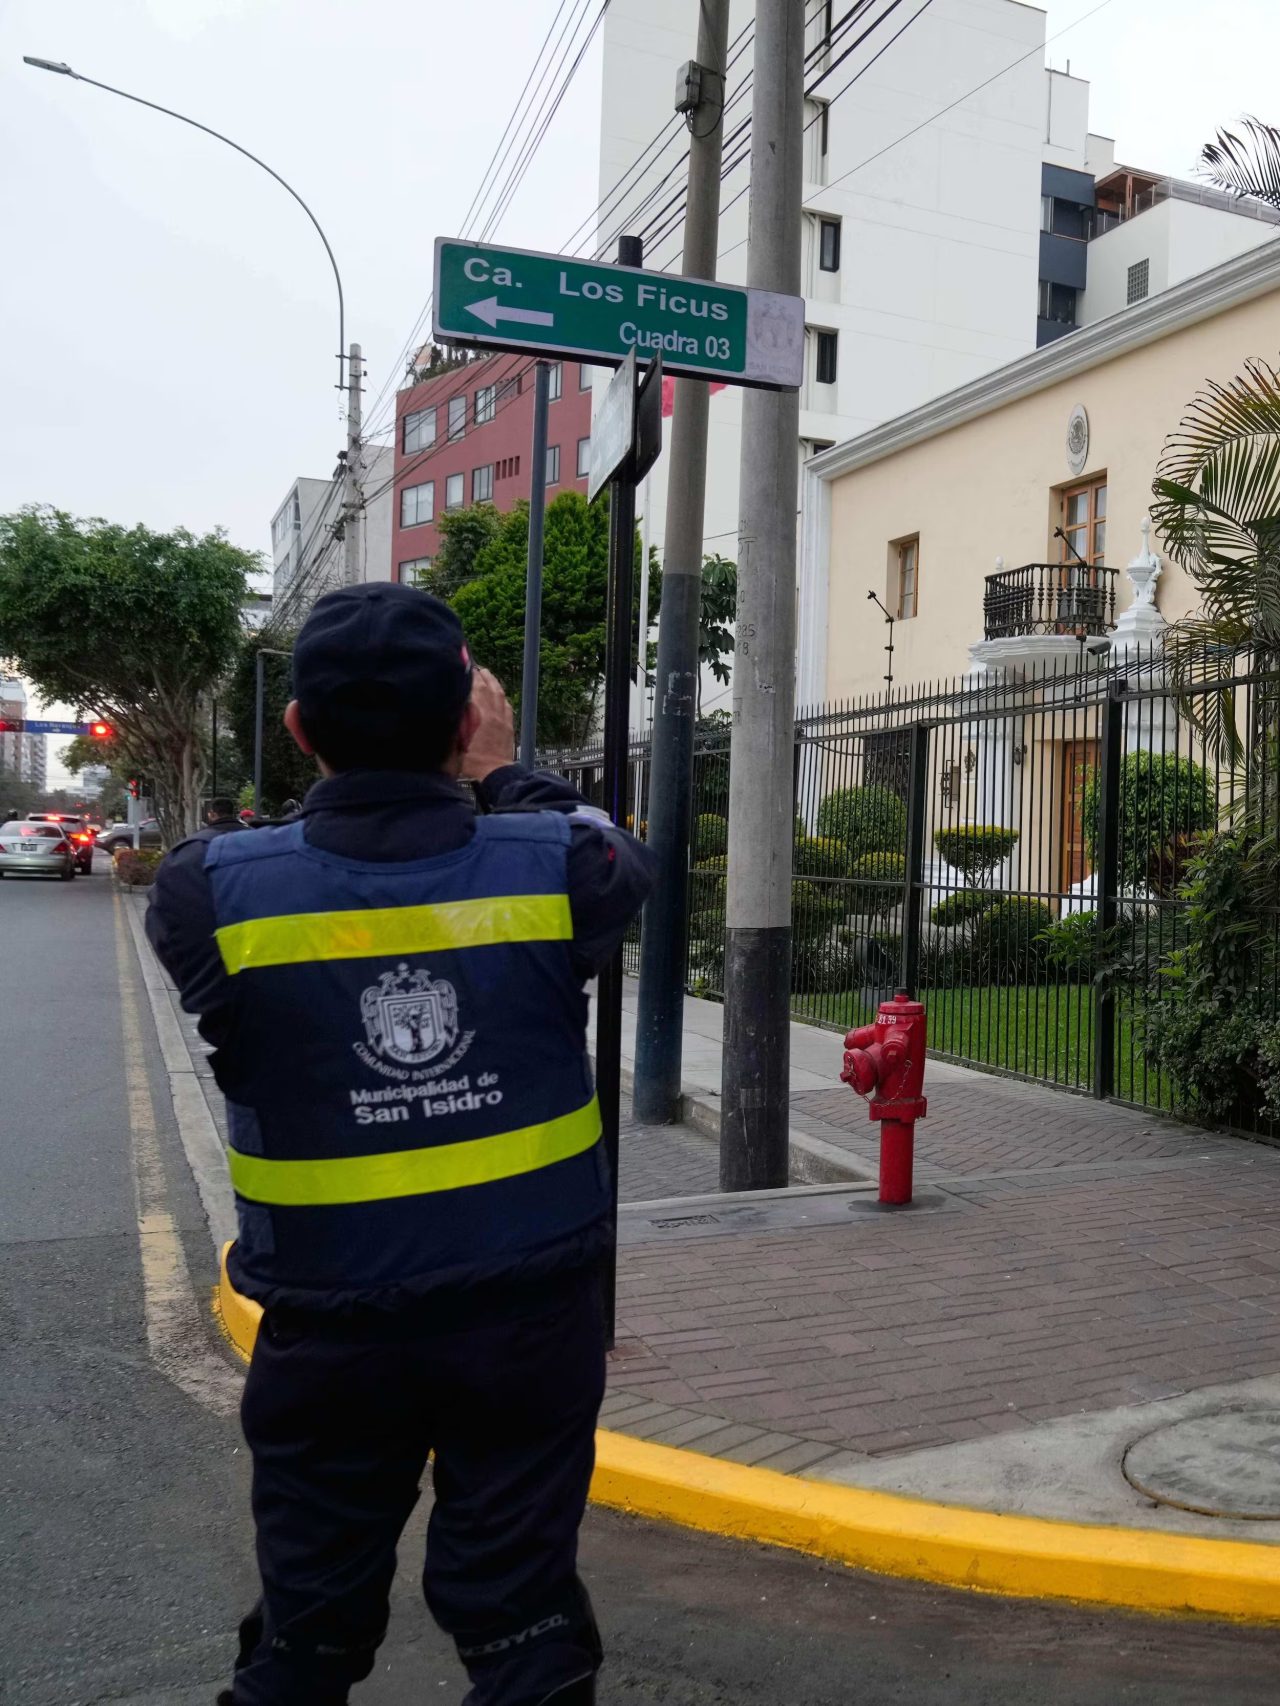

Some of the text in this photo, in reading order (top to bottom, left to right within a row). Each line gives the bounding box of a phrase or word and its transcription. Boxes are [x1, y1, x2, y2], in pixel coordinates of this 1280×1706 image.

[463, 257, 729, 321] Ca. Los Ficus
[619, 321, 731, 360] Cuadra 03
[352, 1041, 410, 1081] COMUNIDAD
[350, 1072, 498, 1105] Municipalidad de
[354, 1090, 503, 1125] San Isidro
